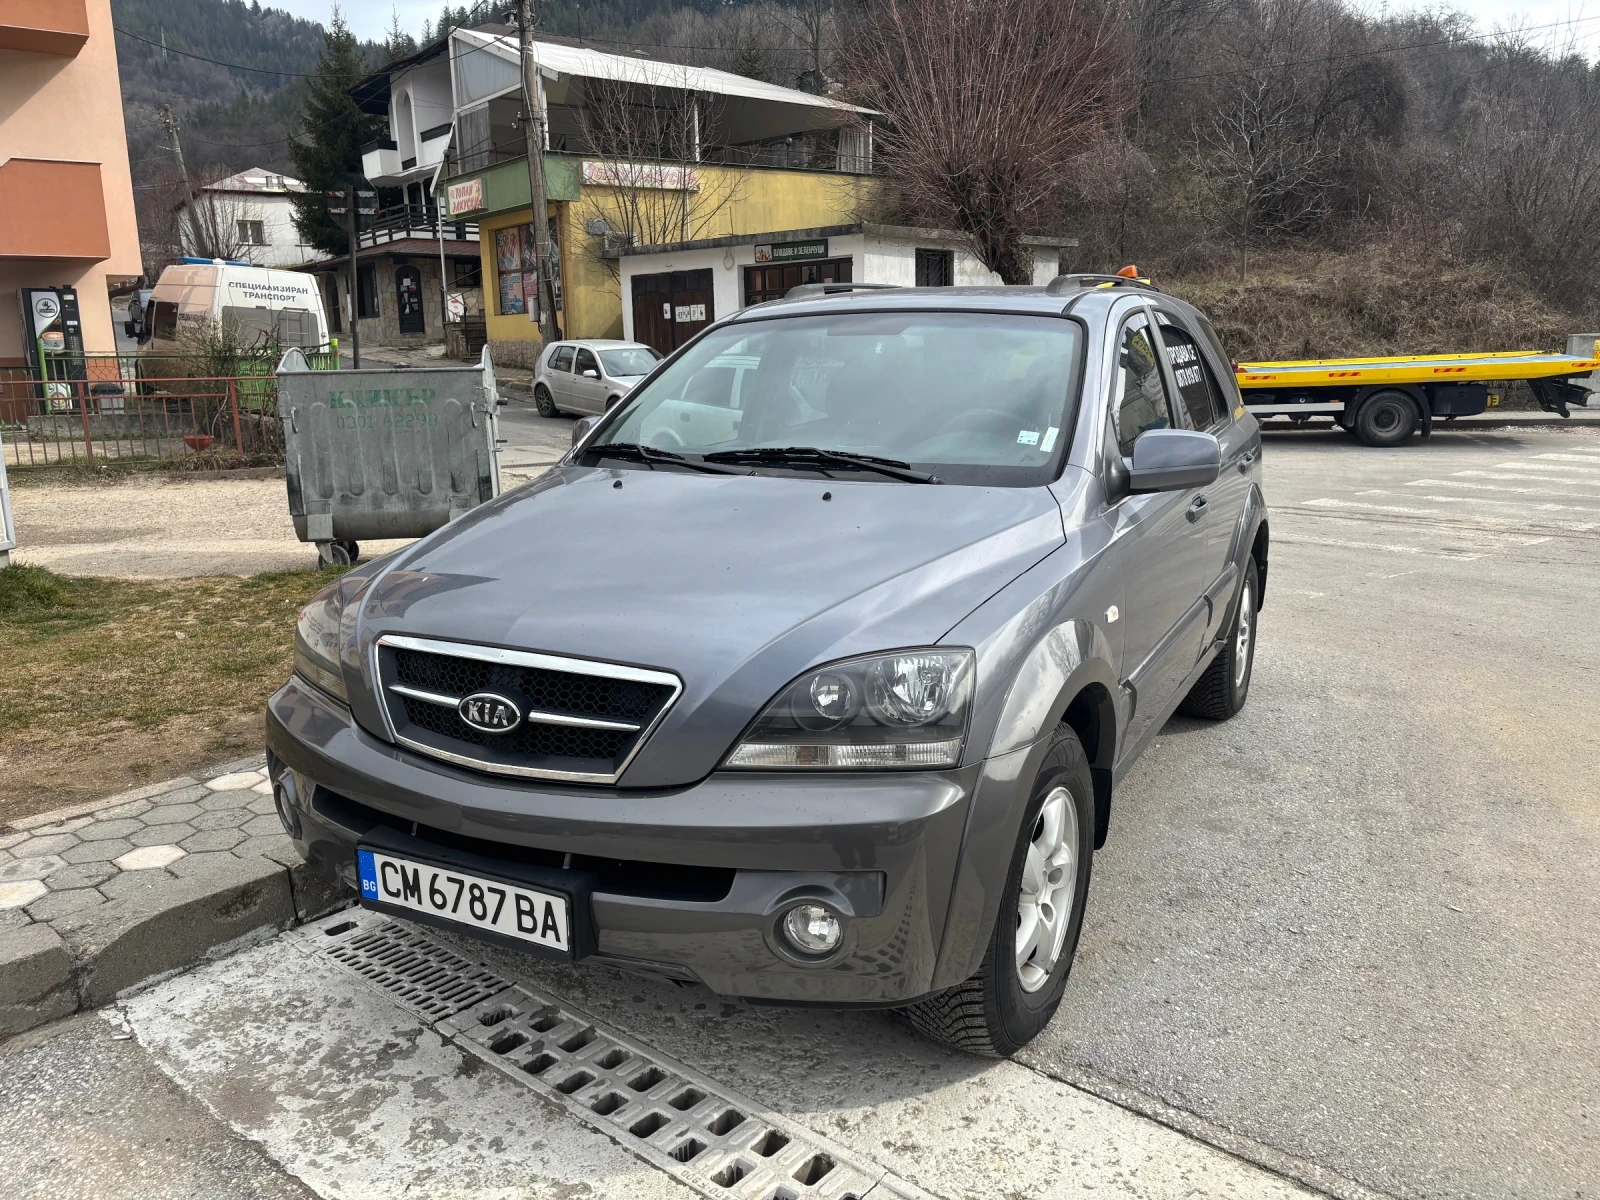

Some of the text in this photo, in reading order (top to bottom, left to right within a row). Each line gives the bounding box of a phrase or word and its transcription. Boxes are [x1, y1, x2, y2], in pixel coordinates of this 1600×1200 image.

[228, 281, 308, 295] СПЕЦИАЛИЗИРАН
[243, 291, 297, 303] ТРАНСПОРТ
[468, 700, 509, 727] KIA
[362, 879, 377, 892] BG
[380, 860, 561, 943] CM 6787 BA
